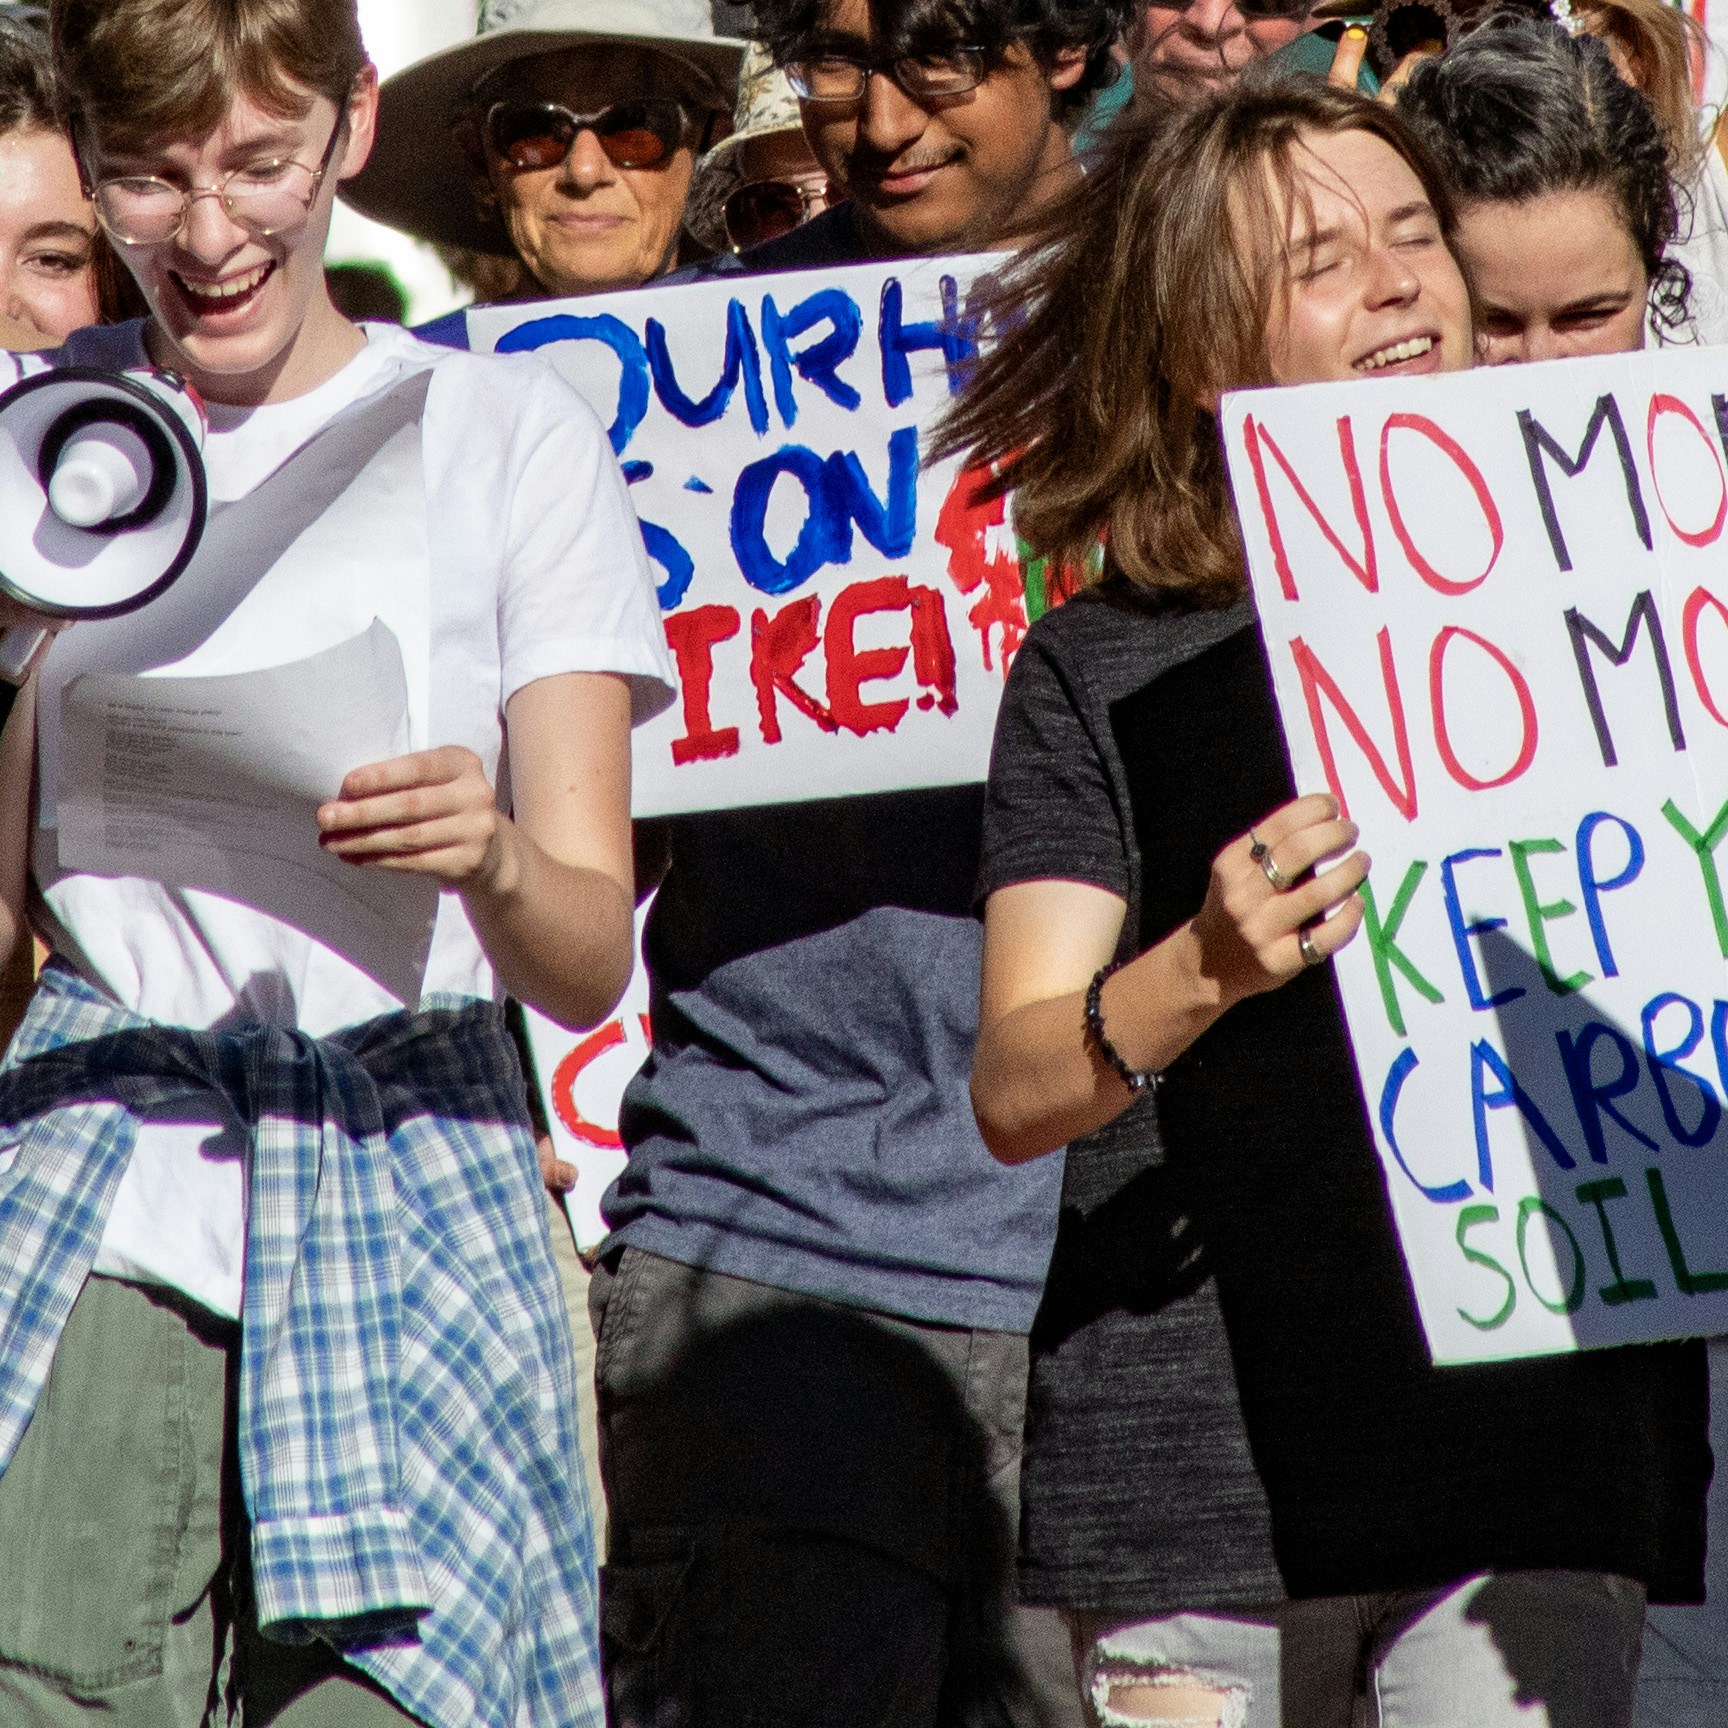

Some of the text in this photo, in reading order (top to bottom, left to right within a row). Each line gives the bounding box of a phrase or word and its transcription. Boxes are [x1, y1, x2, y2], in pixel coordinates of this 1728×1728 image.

[729, 424, 919, 596] ON
[1242, 411, 1505, 602] NO
[1287, 624, 1539, 823] NO
[1356, 810, 1646, 1038] KEEP
